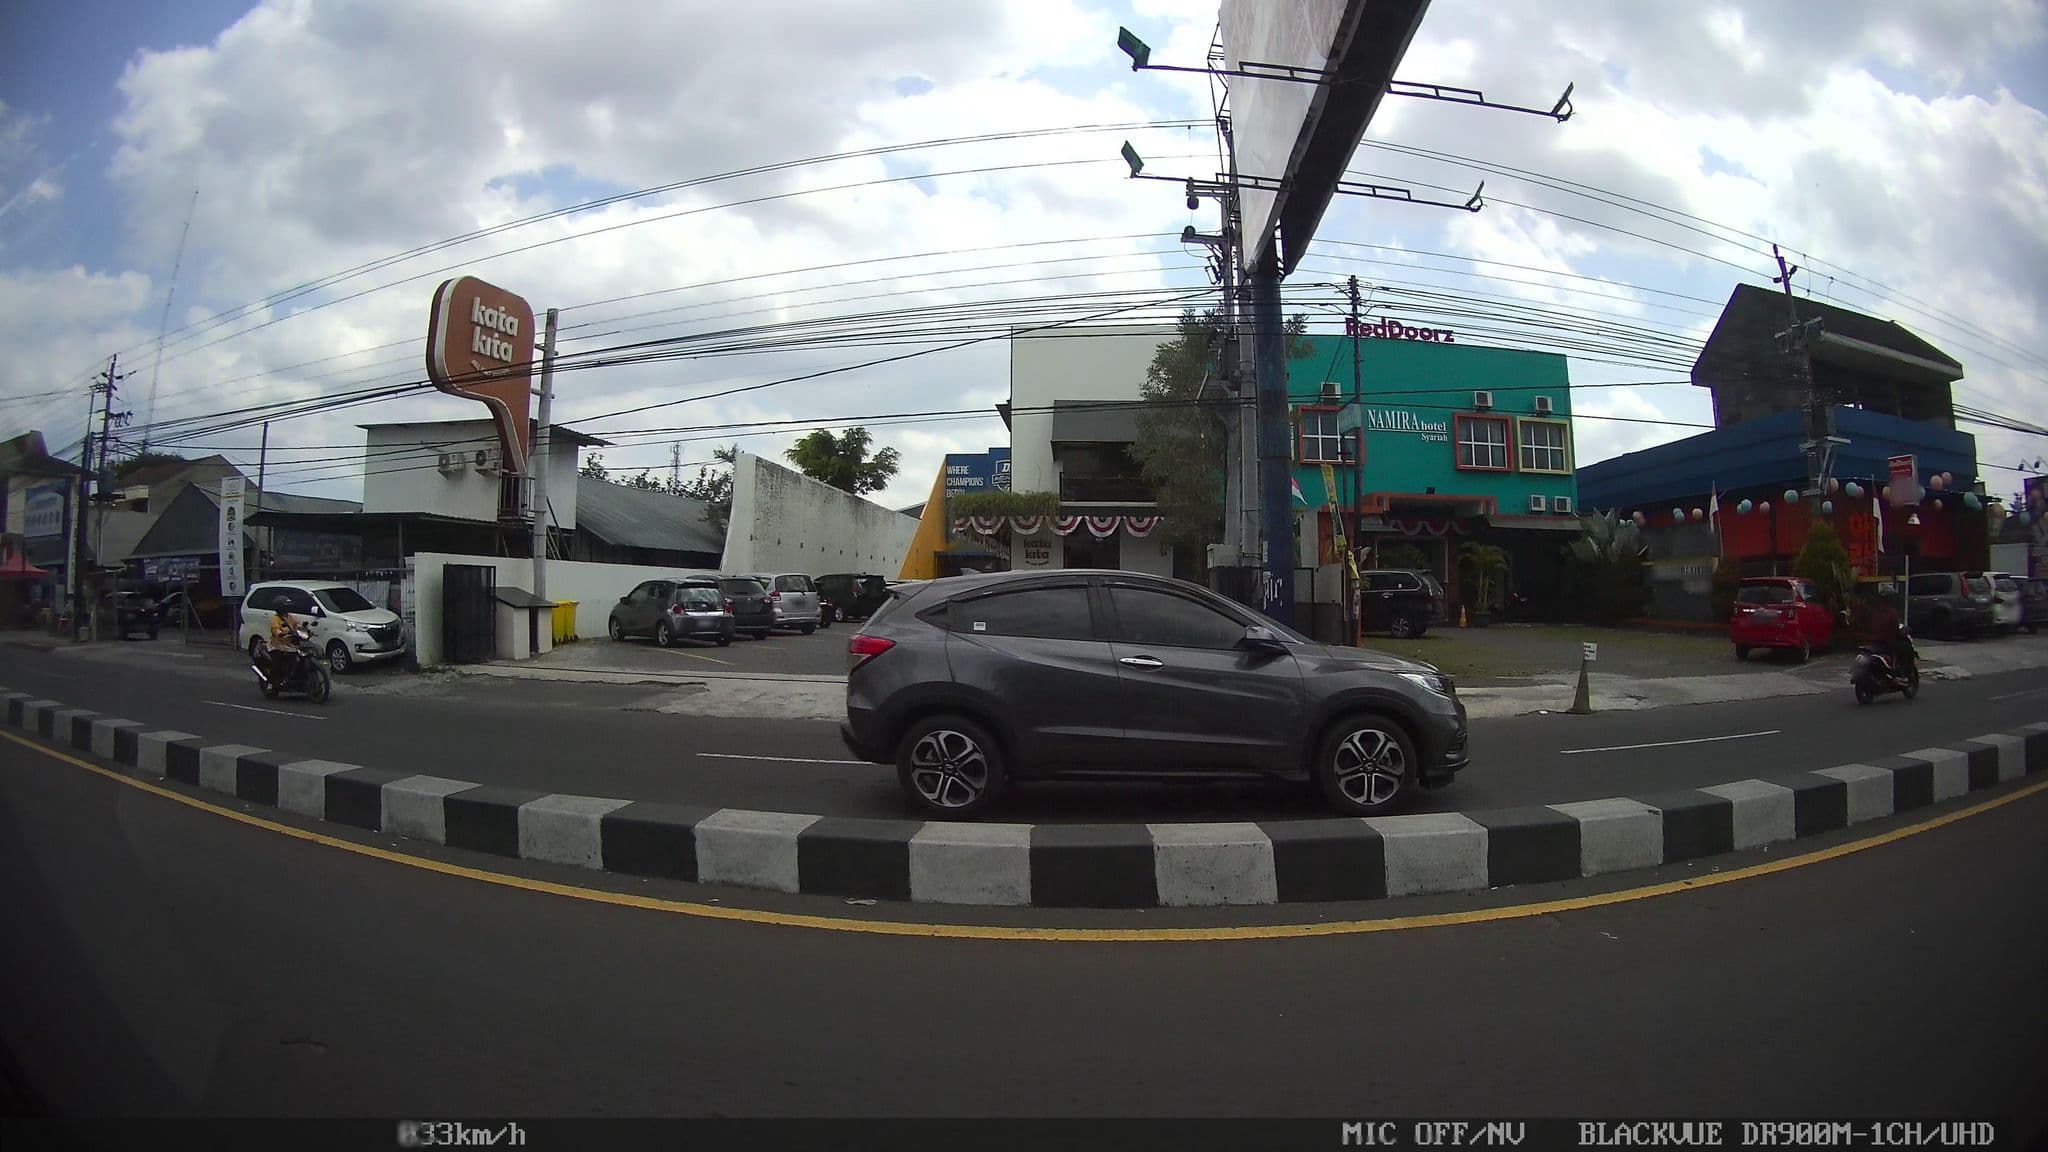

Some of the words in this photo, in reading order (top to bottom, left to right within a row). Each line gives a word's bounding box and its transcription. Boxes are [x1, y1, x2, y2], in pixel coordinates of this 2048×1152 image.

[471, 296, 519, 337] kata
[1345, 317, 1455, 342] RedDoorz
[472, 326, 514, 363] kita
[1368, 409, 1420, 430] NAMIRA
[1421, 421, 1446, 432] hotel
[1421, 432, 1448, 442] Syariah
[946, 465, 970, 475] WHERE
[946, 477, 984, 487] CHAMPIONS
[1025, 549, 1049, 559] kita
